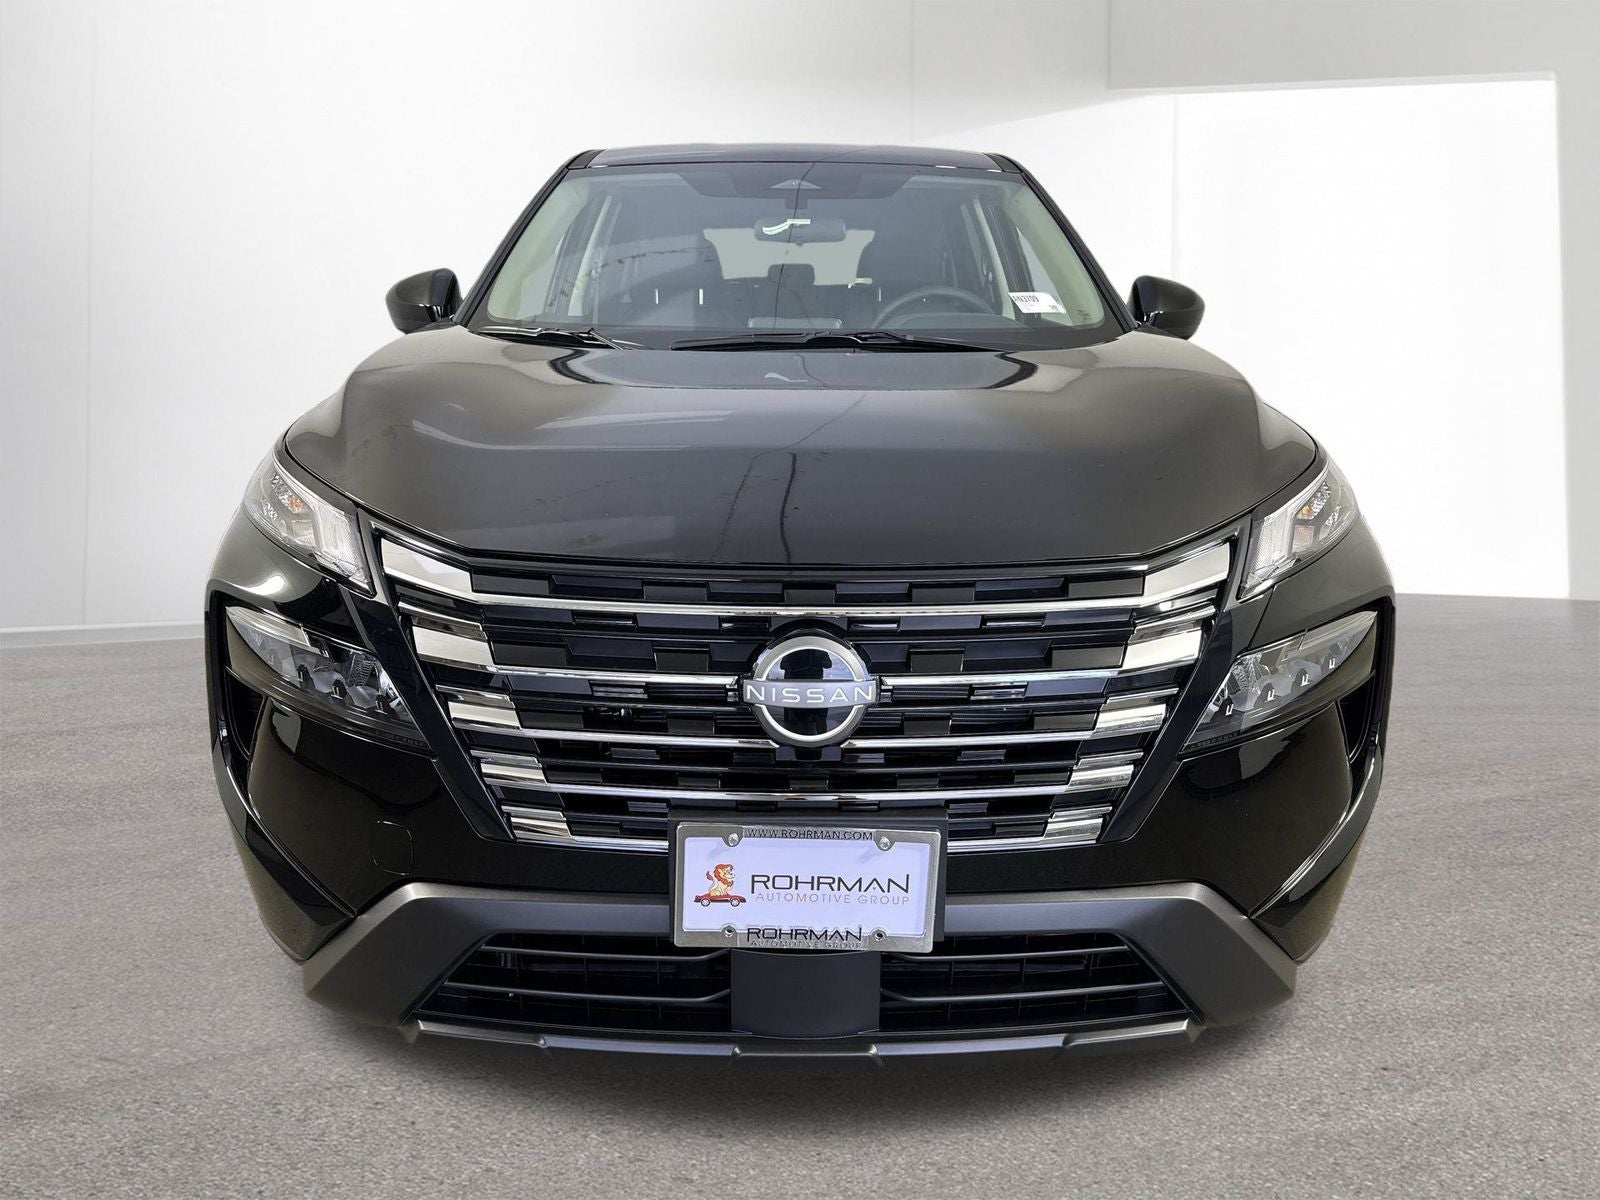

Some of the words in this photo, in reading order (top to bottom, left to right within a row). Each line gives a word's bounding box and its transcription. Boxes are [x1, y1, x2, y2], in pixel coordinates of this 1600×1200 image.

[747, 685, 873, 703] NISSAN
[747, 828, 873, 840] WWW.ROHRMAN.COM
[750, 873, 910, 894] ROHRMAN
[755, 892, 851, 904] AUTOMOTIVE
[858, 895, 910, 905] GROUP
[746, 927, 862, 942] ROHRMAN
[750, 940, 822, 949] AUTOMOTIVE
[824, 941, 862, 950] GROUP
